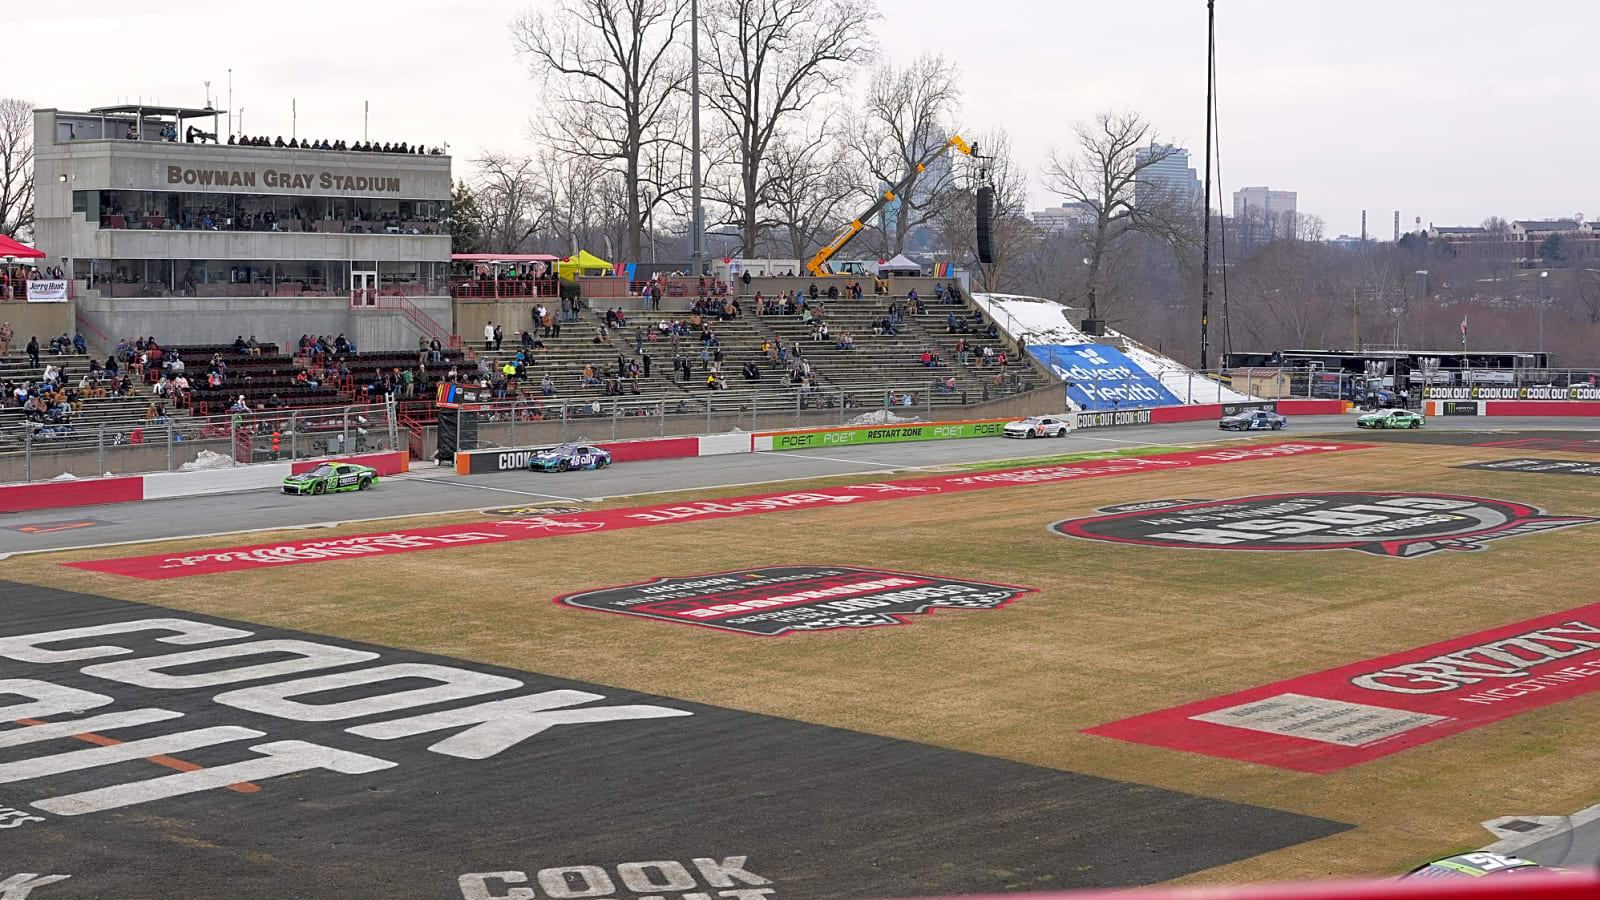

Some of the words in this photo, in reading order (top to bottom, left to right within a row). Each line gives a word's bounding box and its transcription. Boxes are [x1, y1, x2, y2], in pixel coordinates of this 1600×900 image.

[167, 165, 256, 187] BOWMAN
[263, 169, 315, 189] GRAY
[319, 172, 400, 192] STADIUM
[1051, 364, 1140, 380] Advent
[1076, 383, 1164, 400] Health
[1430, 387, 1452, 398] COOK
[1454, 387, 1470, 398] OUT
[1478, 387, 1501, 399] COOK
[1502, 388, 1518, 399] OUT
[1527, 388, 1551, 399] COOK
[1551, 388, 1568, 399] OUT
[1077, 413, 1097, 428] COOK
[1100, 412, 1114, 426] OUT
[1115, 411, 1134, 425] COOK
[1137, 410, 1151, 423] OUT
[1251, 419, 1260, 428] 2
[1386, 417, 1397, 426] 42
[867, 429, 901, 439] RESTART
[902, 427, 923, 437] ZONE
[934, 425, 964, 437] POET
[974, 423, 1001, 434] POET
[781, 435, 814, 446] POET
[823, 432, 856, 444] POET
[570, 455, 580, 467] 48
[580, 453, 597, 465] ally
[327, 475, 339, 489] 16
[1143, 497, 1478, 544] CLASH
[678, 578, 918, 617] MADHOUSE
[1458, 666, 1588, 705] NICOTINE
[458, 855, 774, 900] COOK
